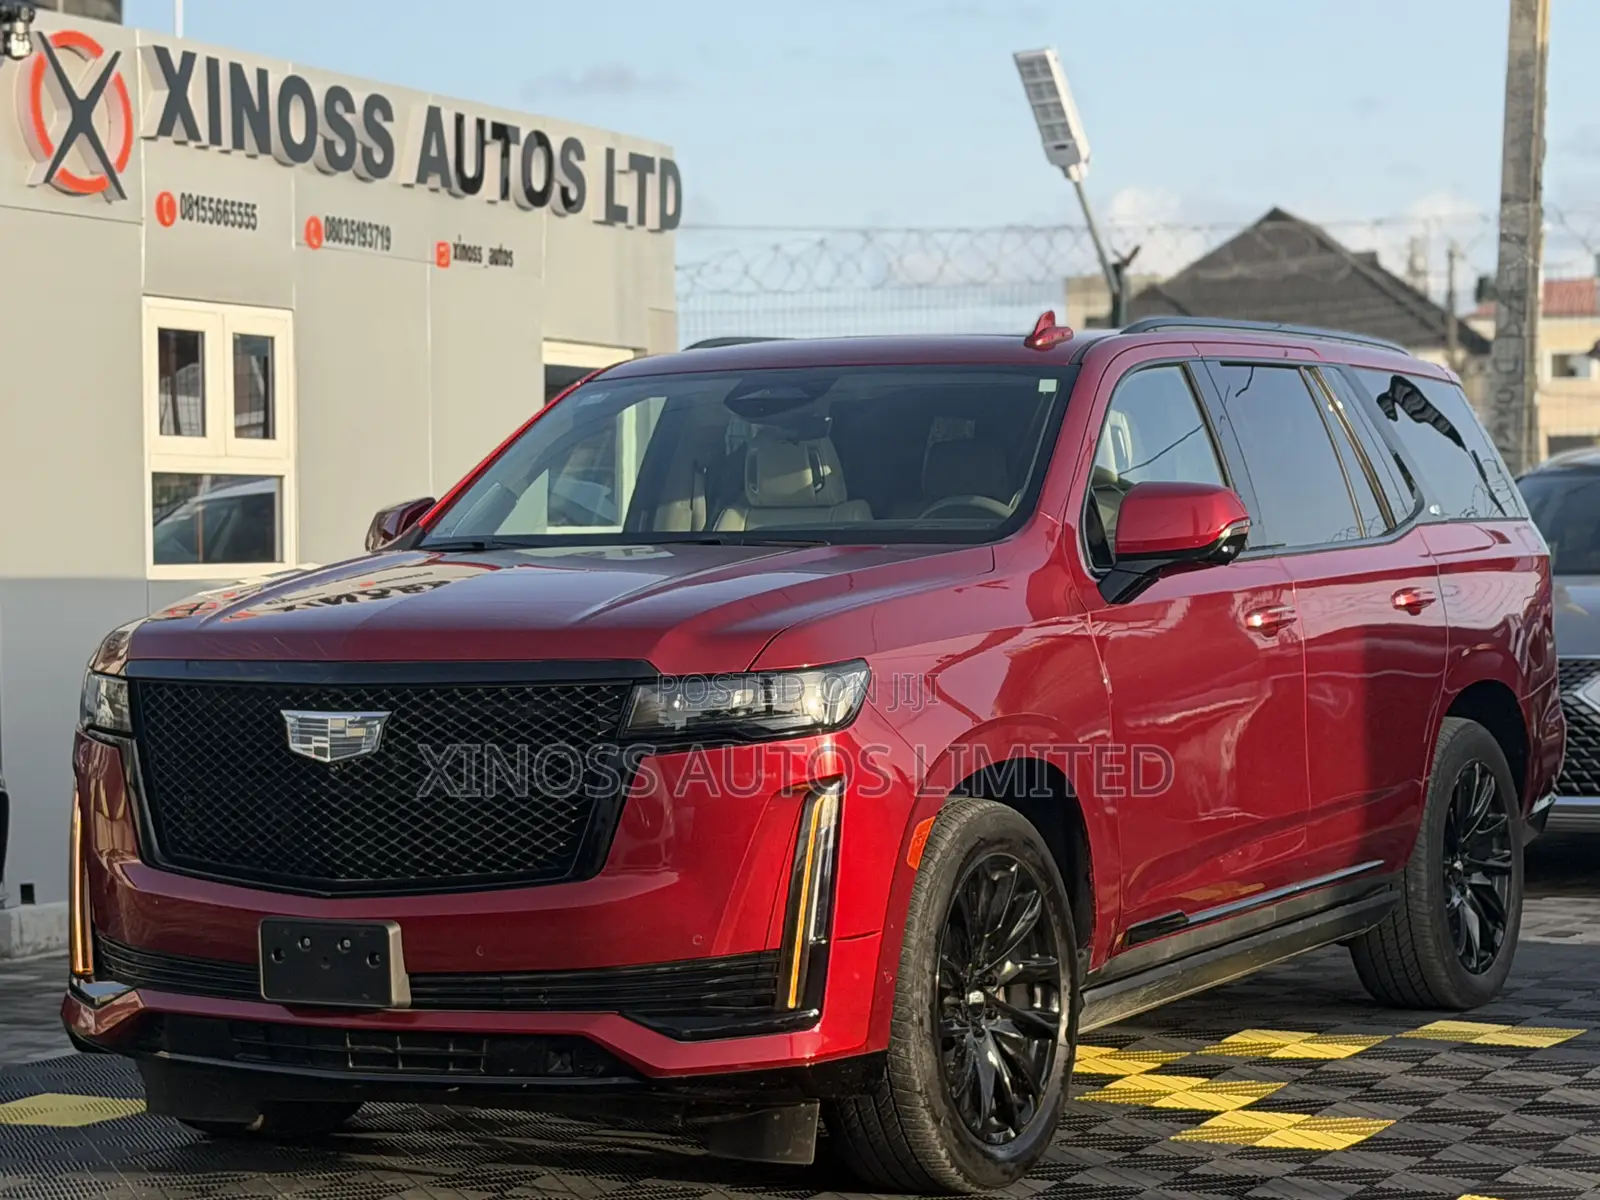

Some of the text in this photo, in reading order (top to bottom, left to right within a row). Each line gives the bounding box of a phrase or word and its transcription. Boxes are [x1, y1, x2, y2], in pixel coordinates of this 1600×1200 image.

[150, 44, 682, 231] XINOSS AUTOS LTD
[180, 192, 258, 231] 08155665555
